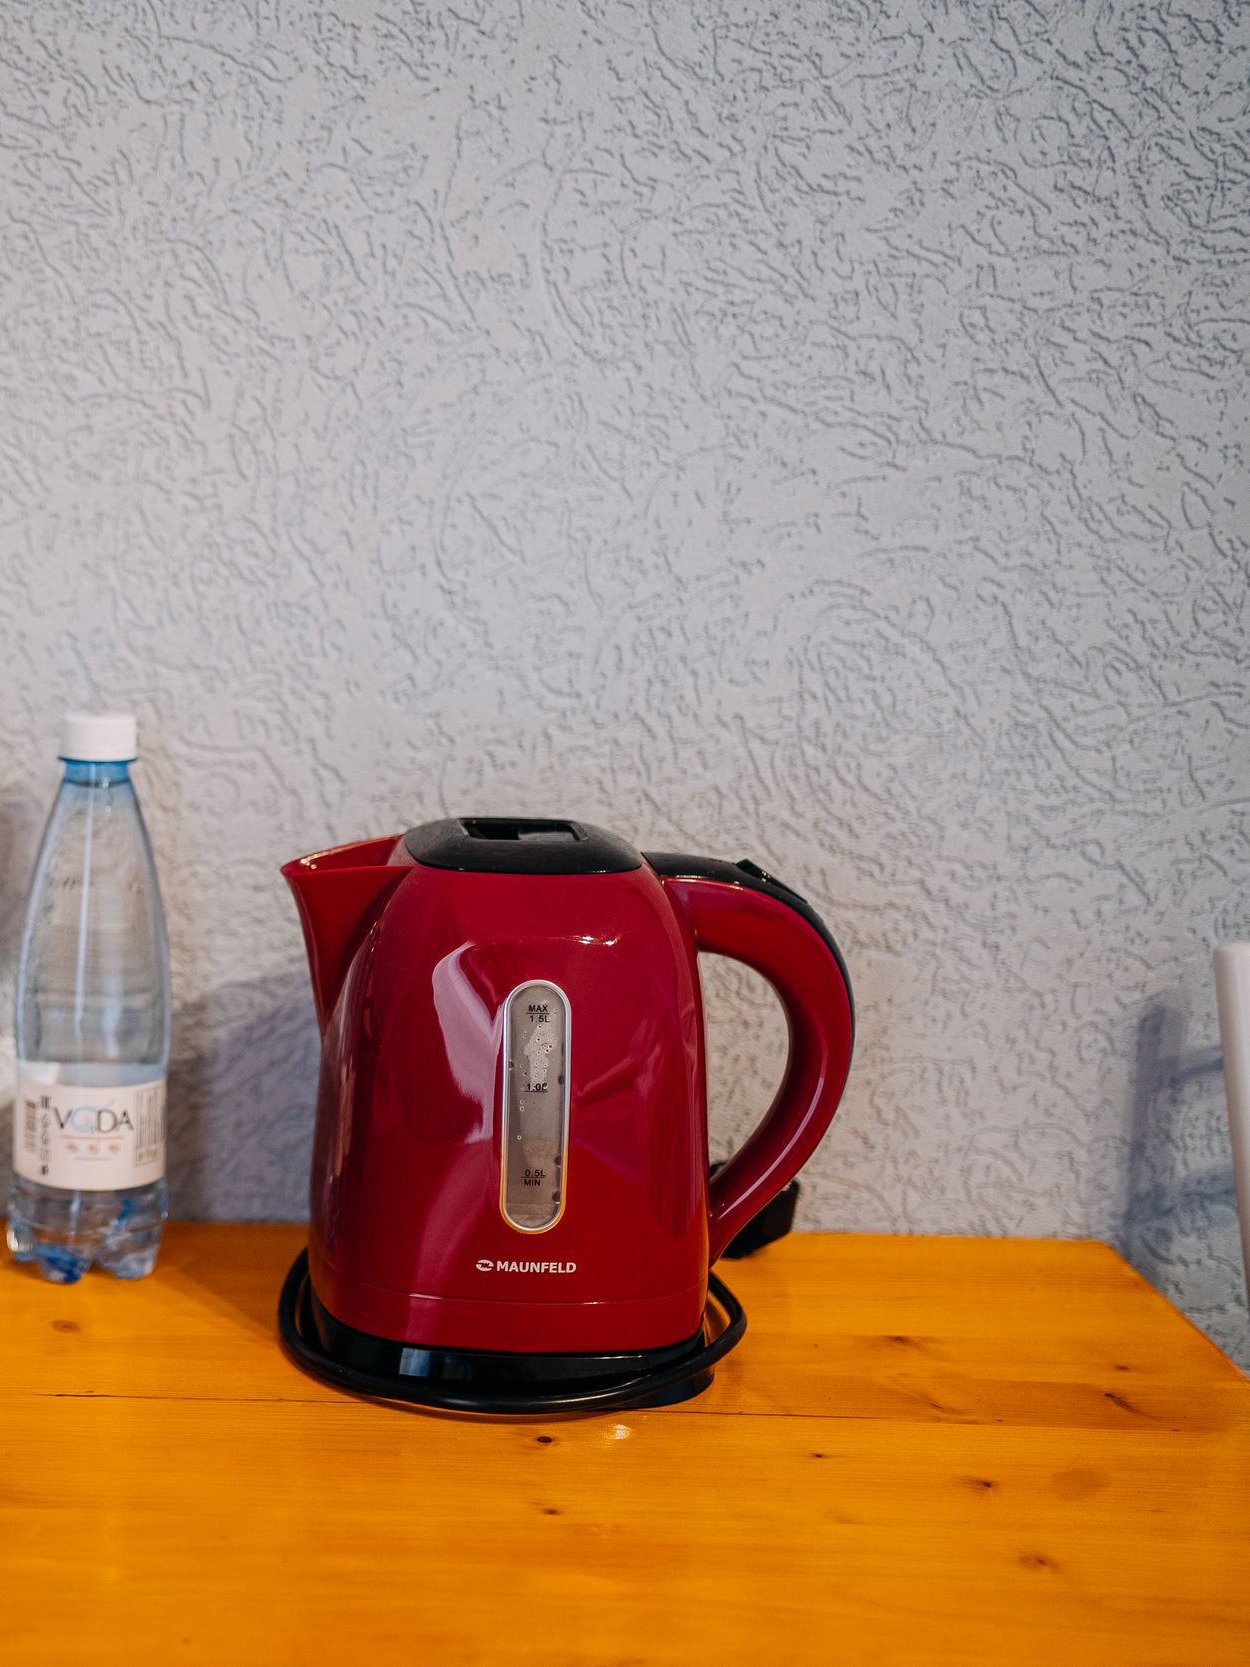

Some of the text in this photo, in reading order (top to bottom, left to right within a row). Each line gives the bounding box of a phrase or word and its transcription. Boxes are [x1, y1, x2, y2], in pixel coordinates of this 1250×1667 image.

[528, 1004, 548, 1013] MAX
[530, 1014, 550, 1023] 1.5L
[54, 1106, 134, 1133] VODA
[524, 1168, 546, 1177] 0.5L
[496, 1260, 577, 1273] MAUNFELD
